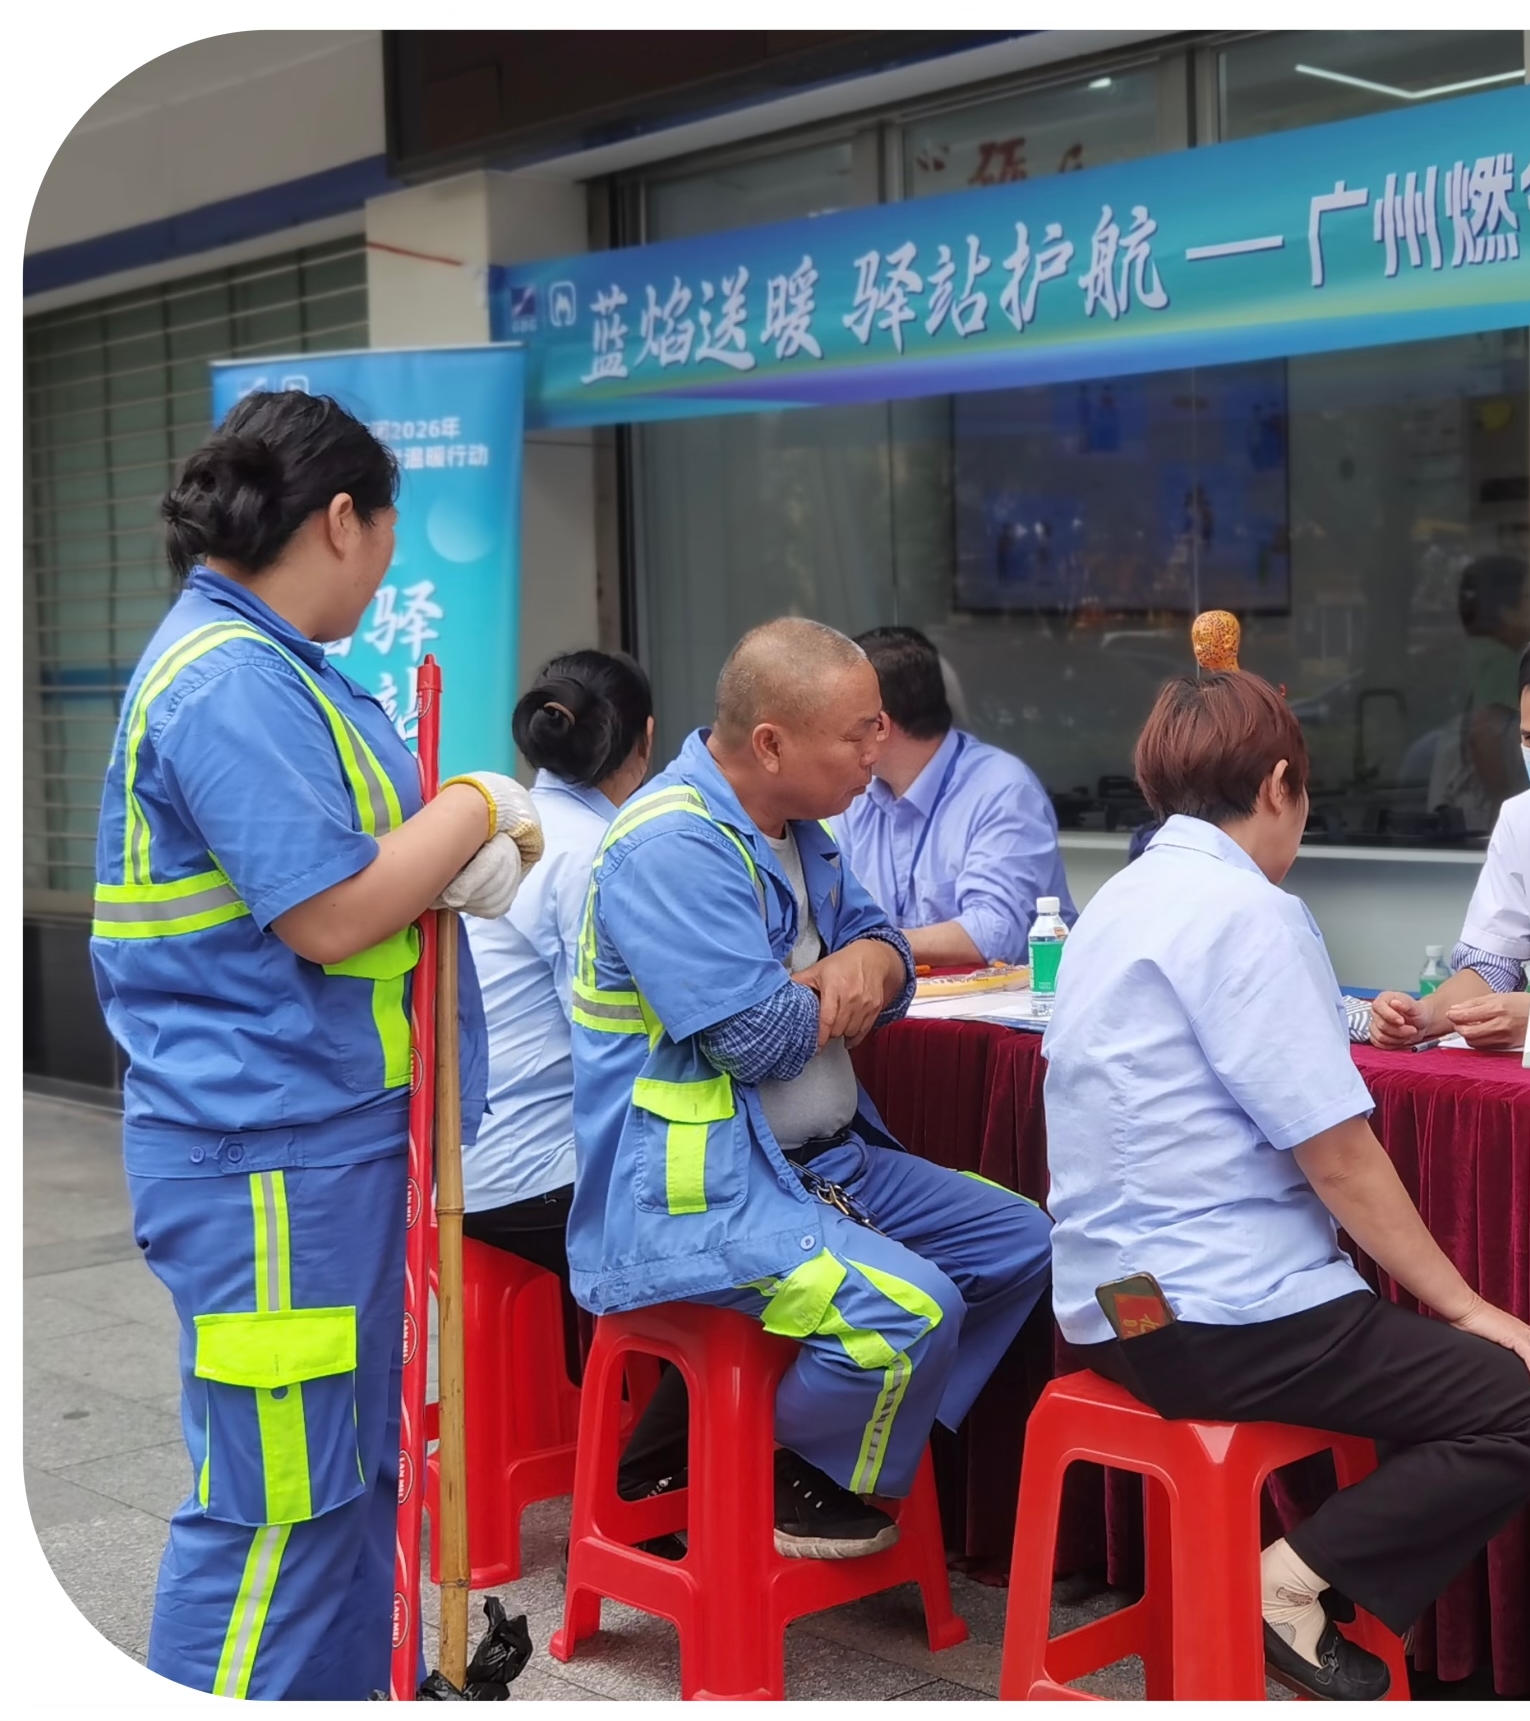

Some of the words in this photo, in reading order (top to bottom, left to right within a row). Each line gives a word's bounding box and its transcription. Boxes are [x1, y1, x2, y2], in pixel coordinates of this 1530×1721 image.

[580, 253, 824, 388] 蓝焰送暖
[841, 202, 1171, 356] 驿站护航
